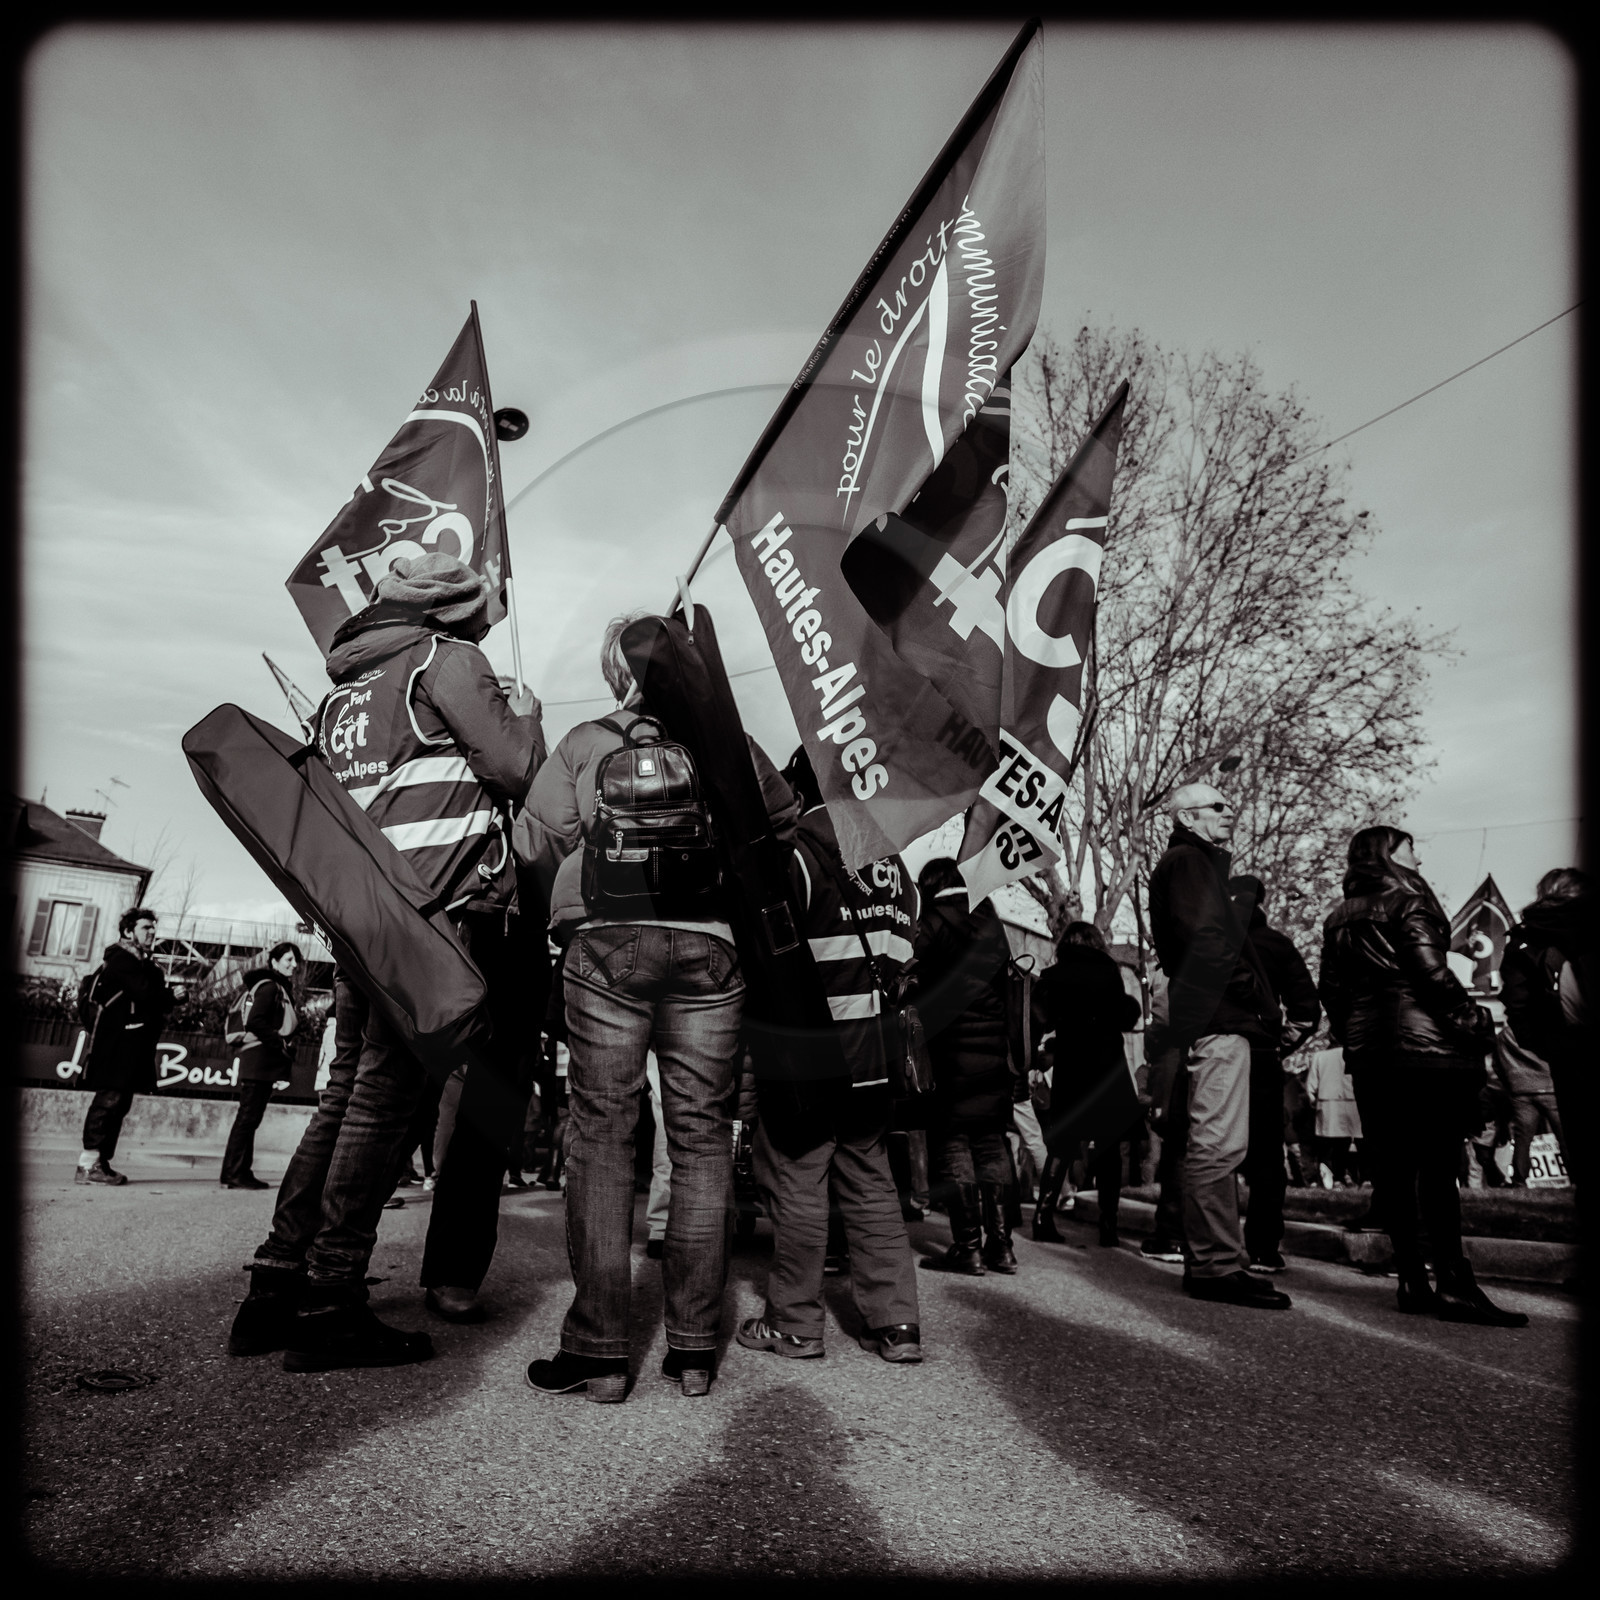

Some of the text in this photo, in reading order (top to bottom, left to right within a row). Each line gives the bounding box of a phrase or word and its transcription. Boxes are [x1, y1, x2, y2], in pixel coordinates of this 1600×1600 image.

[876, 218, 954, 335] droit
[851, 340, 882, 384] le
[837, 395, 867, 498] pour
[750, 511, 889, 801] Hautes-Alpes
[156, 1042, 240, 1088] Bout
